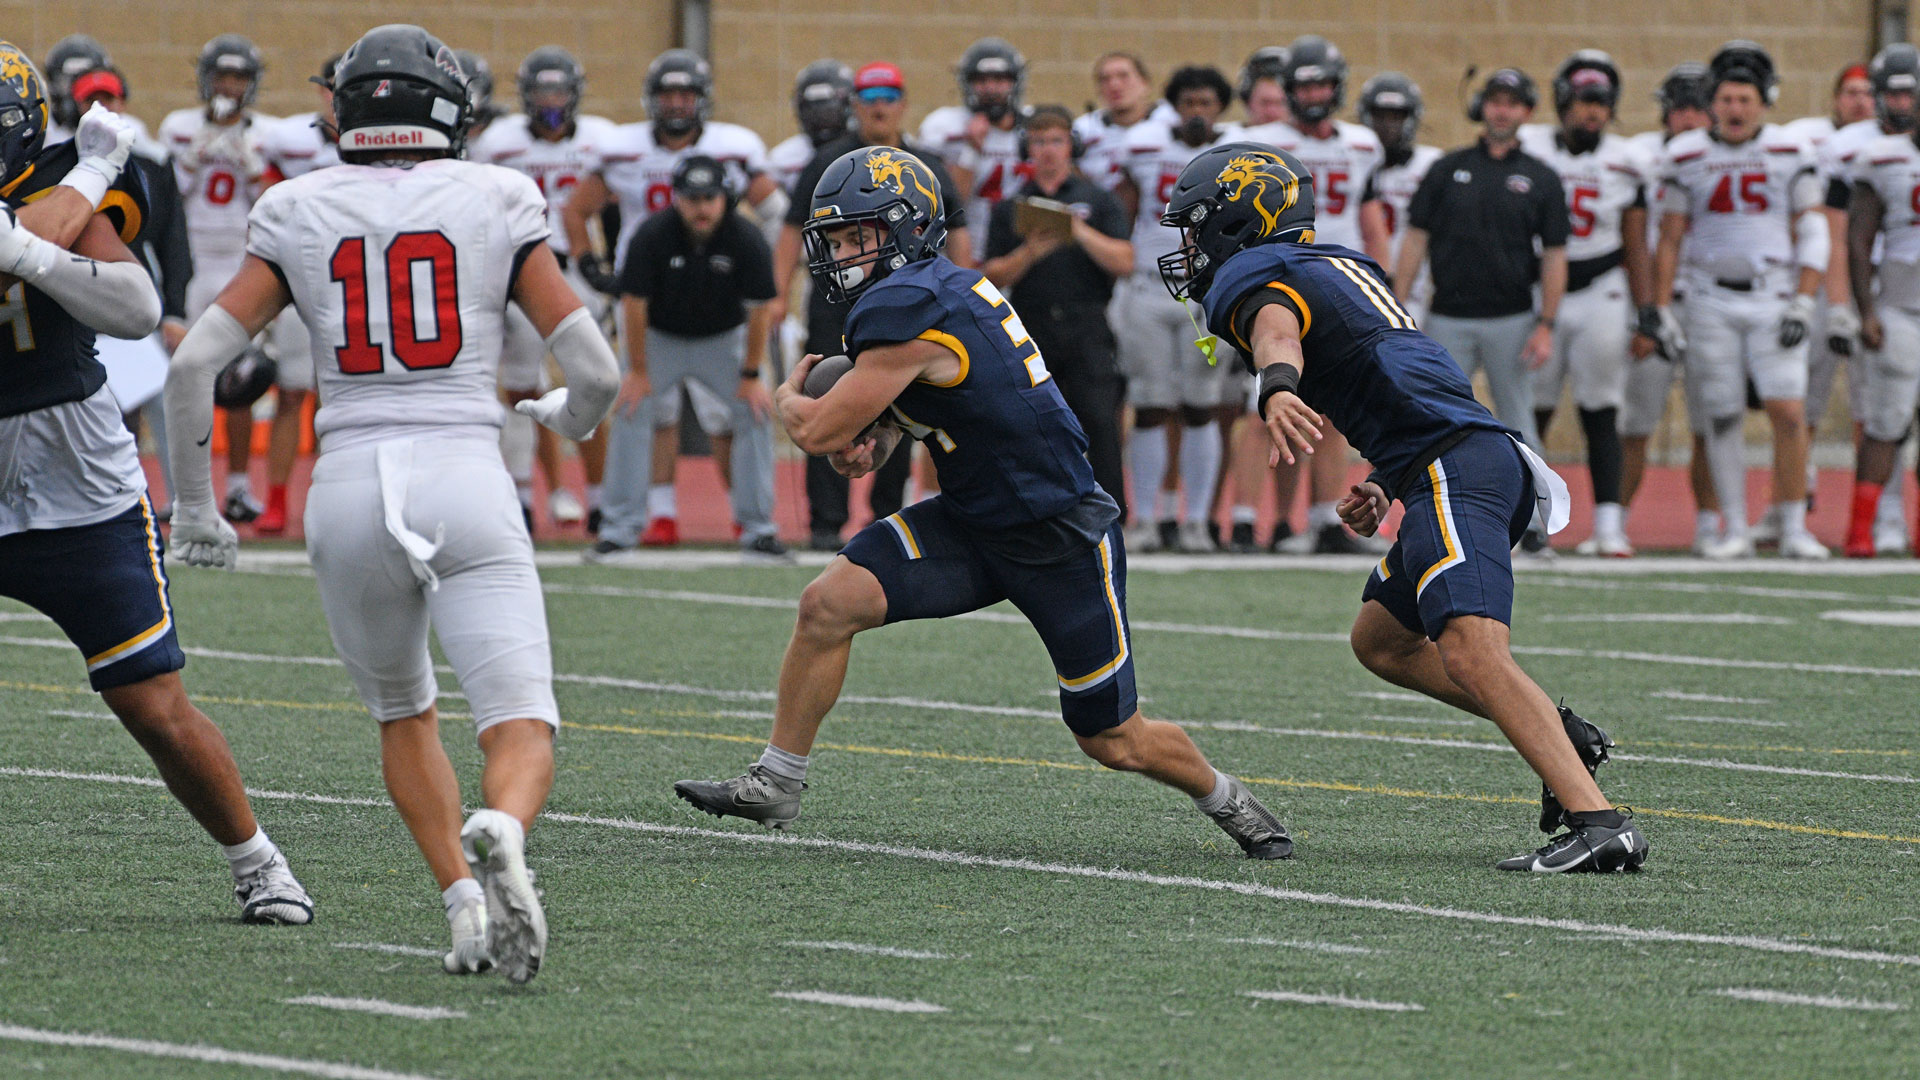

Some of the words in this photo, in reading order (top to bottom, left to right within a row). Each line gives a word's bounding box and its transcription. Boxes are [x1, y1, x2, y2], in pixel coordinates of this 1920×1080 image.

[354, 130, 423, 147] Riddell
[206, 170, 236, 206] 0
[1708, 173, 1768, 213] 45
[328, 229, 463, 376] 10
[1317, 255, 1418, 331] 11
